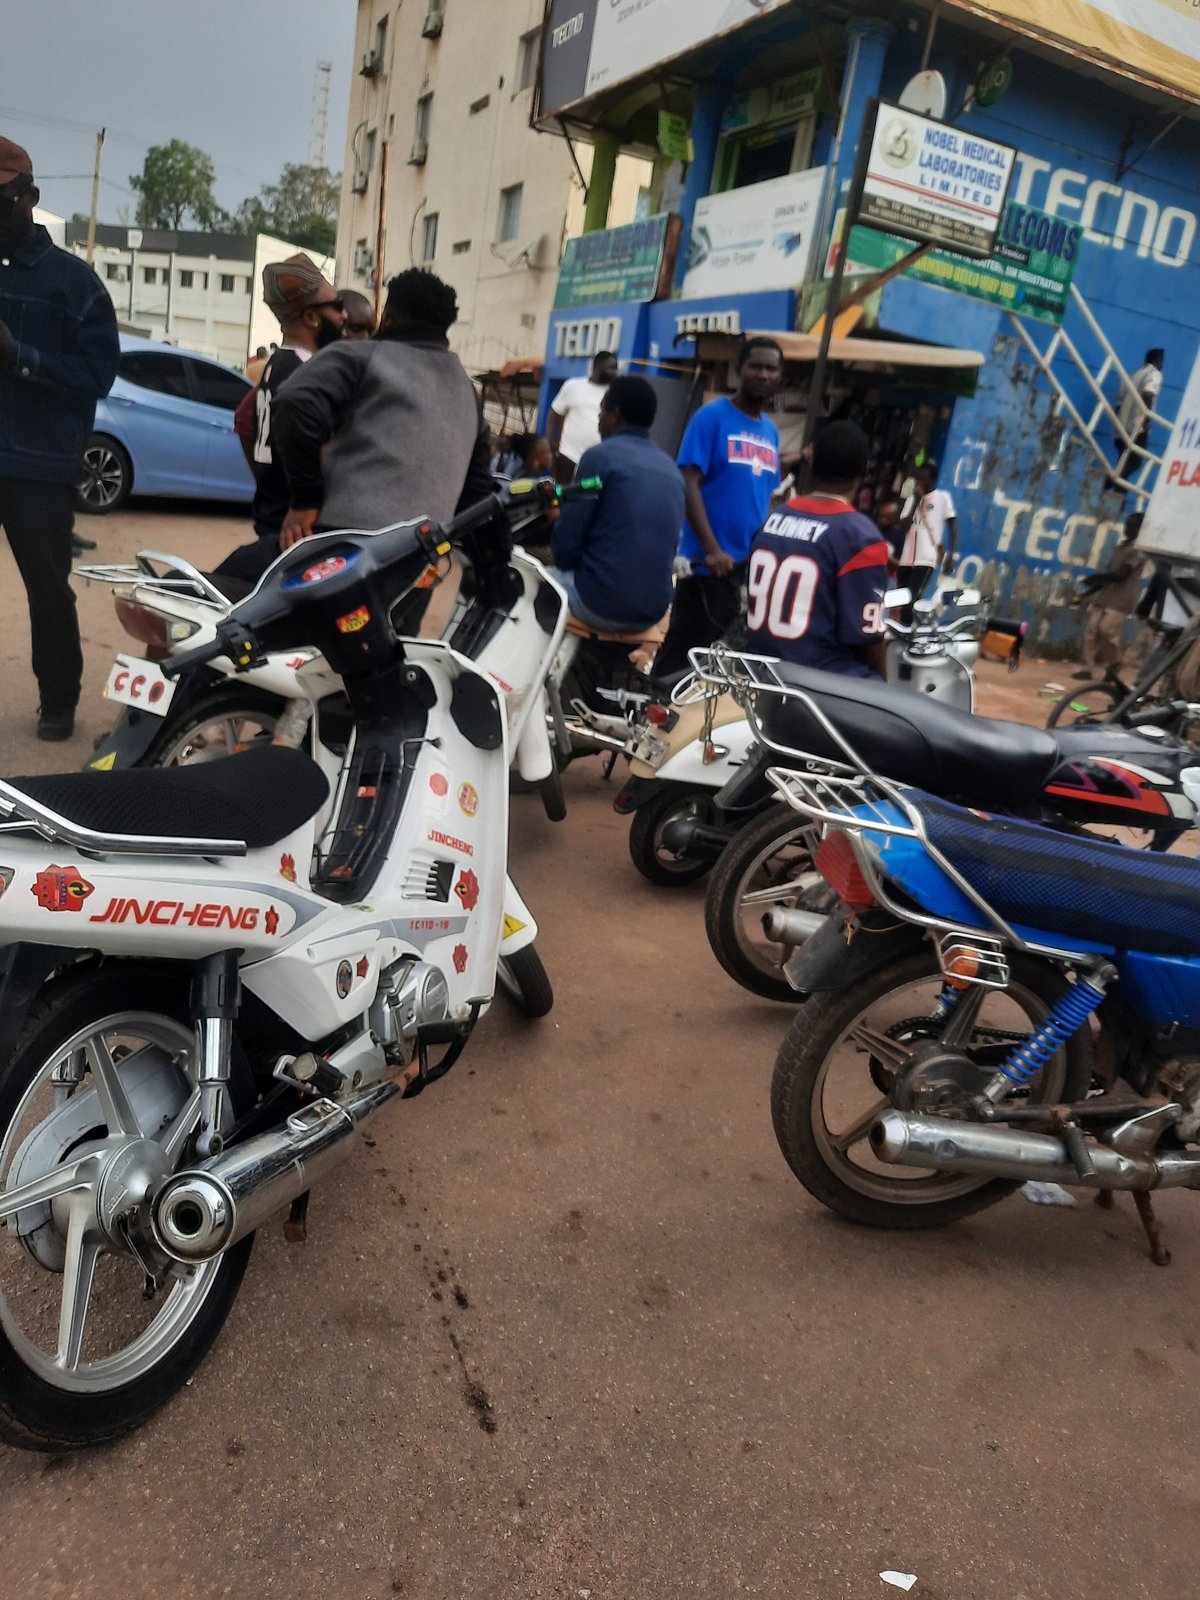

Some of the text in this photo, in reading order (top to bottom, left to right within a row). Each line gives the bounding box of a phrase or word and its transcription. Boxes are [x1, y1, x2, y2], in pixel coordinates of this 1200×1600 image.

[552, 12, 584, 48] TECNO
[924, 128, 1006, 169] NOBEL MEDICAL
[919, 151, 1001, 191] LABORATORIES
[920, 175, 992, 206] LIMITED
[1016, 151, 1197, 268] TECNO
[554, 316, 622, 358] TECNO
[763, 512, 829, 543] CLOWNEY
[747, 548, 820, 640] 90
[428, 829, 474, 857] JINCHENG
[89, 898, 260, 930] JINCHENG
